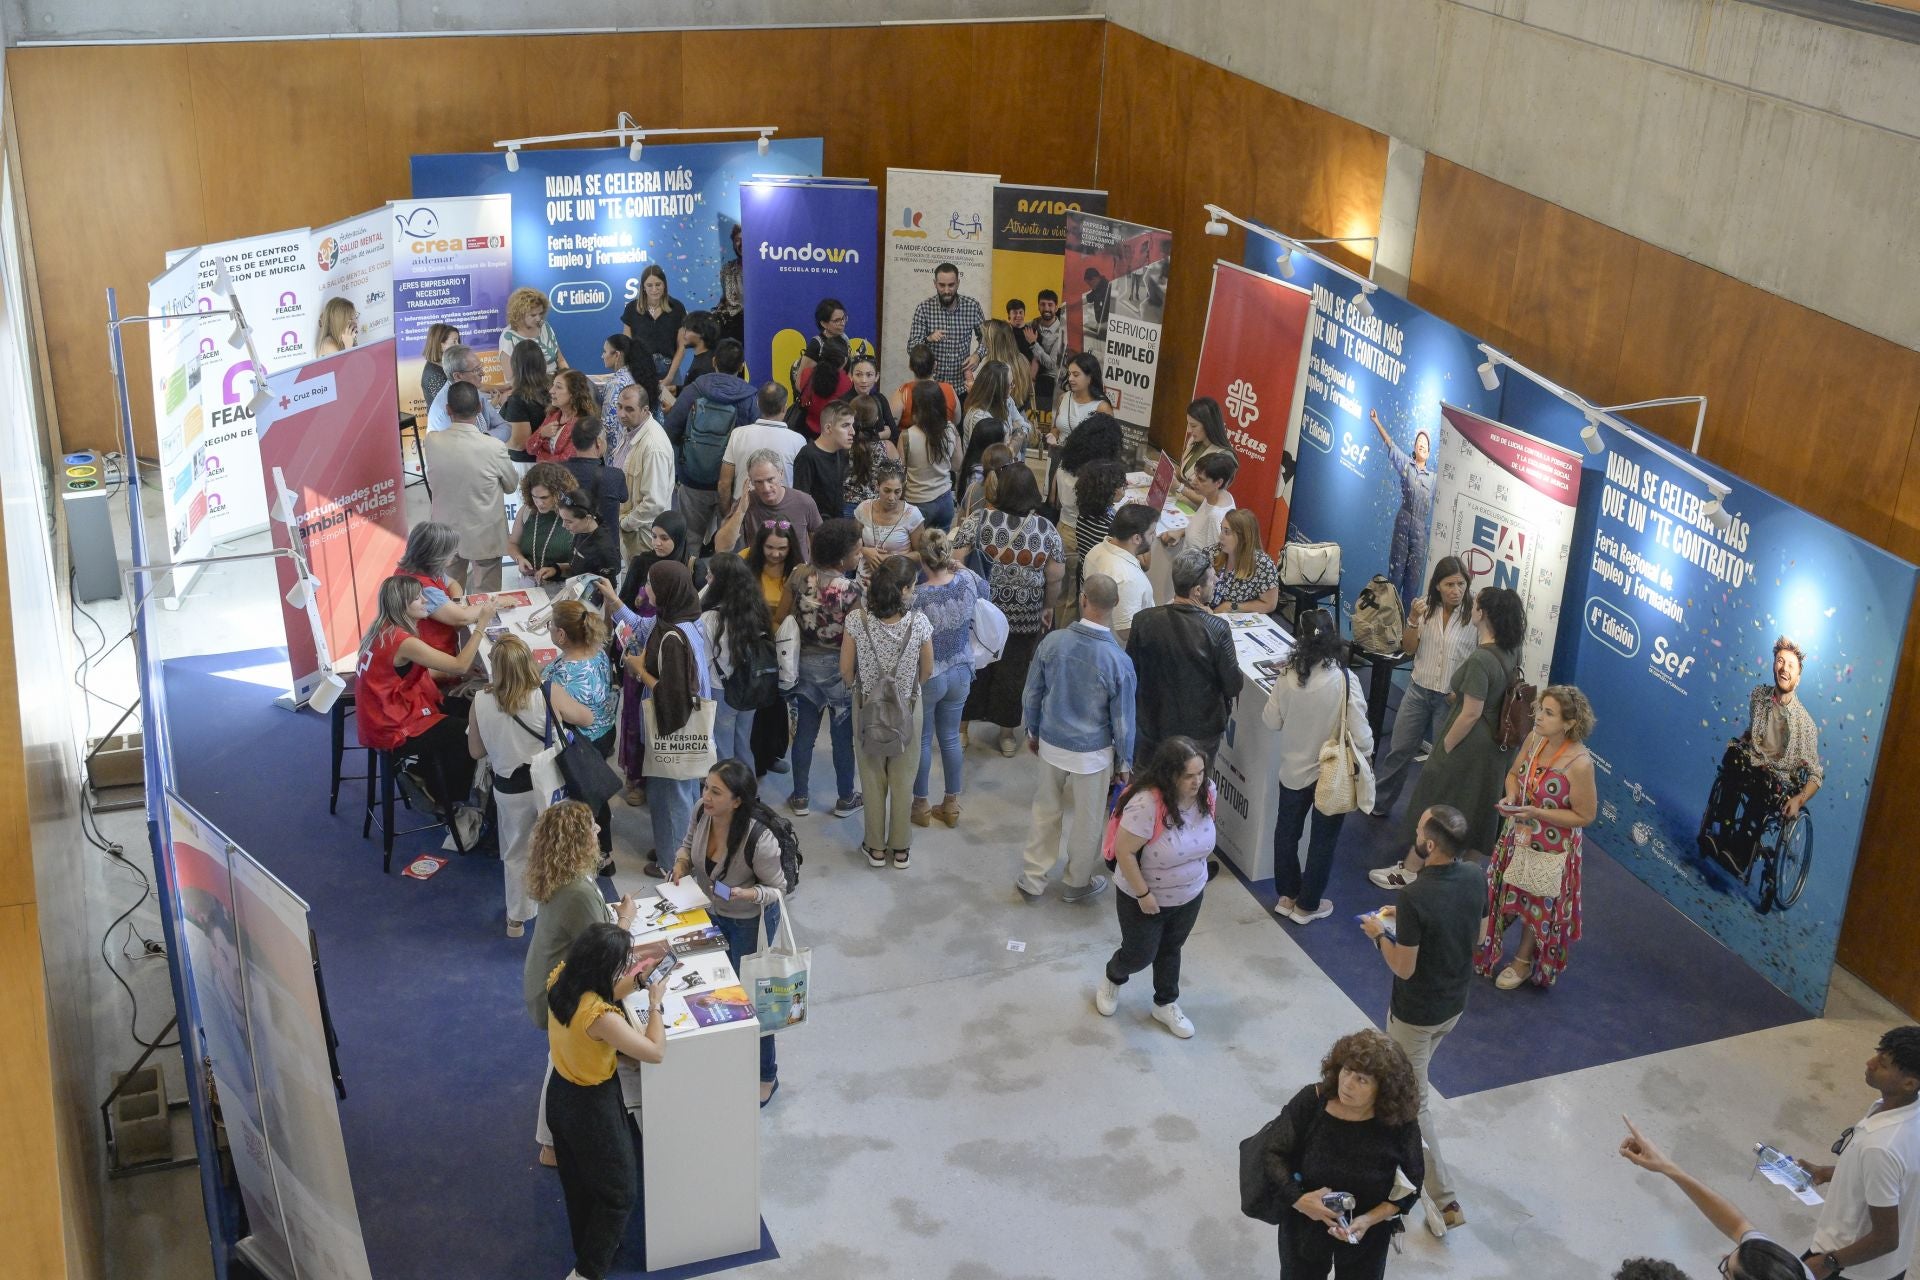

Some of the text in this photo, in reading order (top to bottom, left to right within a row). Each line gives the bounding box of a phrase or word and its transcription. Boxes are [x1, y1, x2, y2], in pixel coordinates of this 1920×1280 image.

[546, 165, 692, 198] NADA SE CELEBRA MÁS
[546, 193, 702, 225] QUE UN "TE CONTRATO"
[548, 232, 632, 252] Feria Regional de
[1052, 226, 1066, 237] vivi
[242, 244, 300, 260] DE CENTROS
[340, 232, 383, 254] SALUD MENTAL
[412, 238, 463, 254] crea
[759, 242, 859, 263] fundown
[244, 260, 256, 270] DE
[259, 254, 296, 267] EMPLEO
[412, 256, 454, 266] aidemar
[548, 248, 648, 270] Empleo y Formación
[254, 270, 266, 278] DE
[270, 264, 306, 276] MURCIA
[326, 276, 345, 288] SALUD
[346, 268, 368, 282] MENTAL
[368, 265, 376, 273] ES
[342, 276, 368, 292] DE TODOS
[399, 281, 419, 292] ¿ERES
[420, 278, 461, 288] EMPRESARIO
[416, 288, 450, 298] NECESITAS
[407, 297, 460, 308] TRABAJADORES?
[557, 290, 568, 306] 4ª
[570, 288, 605, 305] Edición
[276, 304, 302, 314] FEACEM
[404, 314, 440, 322] Información
[1312, 282, 1404, 356] NADA SE CELEBRA MÁS
[1108, 320, 1158, 342] SERVICIO
[200, 350, 220, 360] EACEM
[277, 344, 303, 353] FEACEM
[1106, 340, 1154, 364] EMPLEO
[1148, 342, 1156, 350] DE
[1314, 314, 1406, 386] UE UN "TE CONTRATO"
[1108, 358, 1120, 366] CON
[1105, 366, 1150, 389] APOYO
[1320, 358, 1356, 394] Regional de
[293, 386, 328, 402] Cruz Roja
[1323, 384, 1362, 420] y Formación
[240, 428, 253, 438] DE
[1226, 428, 1268, 454] ritas
[1310, 416, 1330, 446] Edición
[1235, 444, 1265, 462] Cartagena
[1340, 432, 1370, 464] Sef
[1500, 438, 1508, 446] DE
[1508, 440, 1524, 452] LUCHA
[1551, 456, 1572, 470] POBREZA
[1512, 462, 1518, 470] DE
[1519, 464, 1525, 472] LA
[1554, 469, 1570, 480] SOCIAL
[1606, 450, 1640, 494] NADA
[1642, 470, 1660, 504] SE
[210, 504, 226, 514] ACEM
[296, 478, 394, 526] portunidades que
[299, 491, 396, 540] ambian vidas
[322, 526, 349, 543] Empleo
[360, 513, 378, 526] Cruz
[380, 506, 397, 519] Roja
[1602, 484, 1754, 588] QUE UN "TE CONTRATO"
[1596, 528, 1674, 591] Feria Regional de
[1592, 551, 1684, 624] Empleo y Formación
[1591, 606, 1634, 650] 4ª Edición
[1650, 636, 1696, 679] Sef
[654, 734, 708, 742] UNIVERSIDAD
[654, 742, 708, 750] DE MURCIA
[1220, 775, 1248, 820] FUTURO
